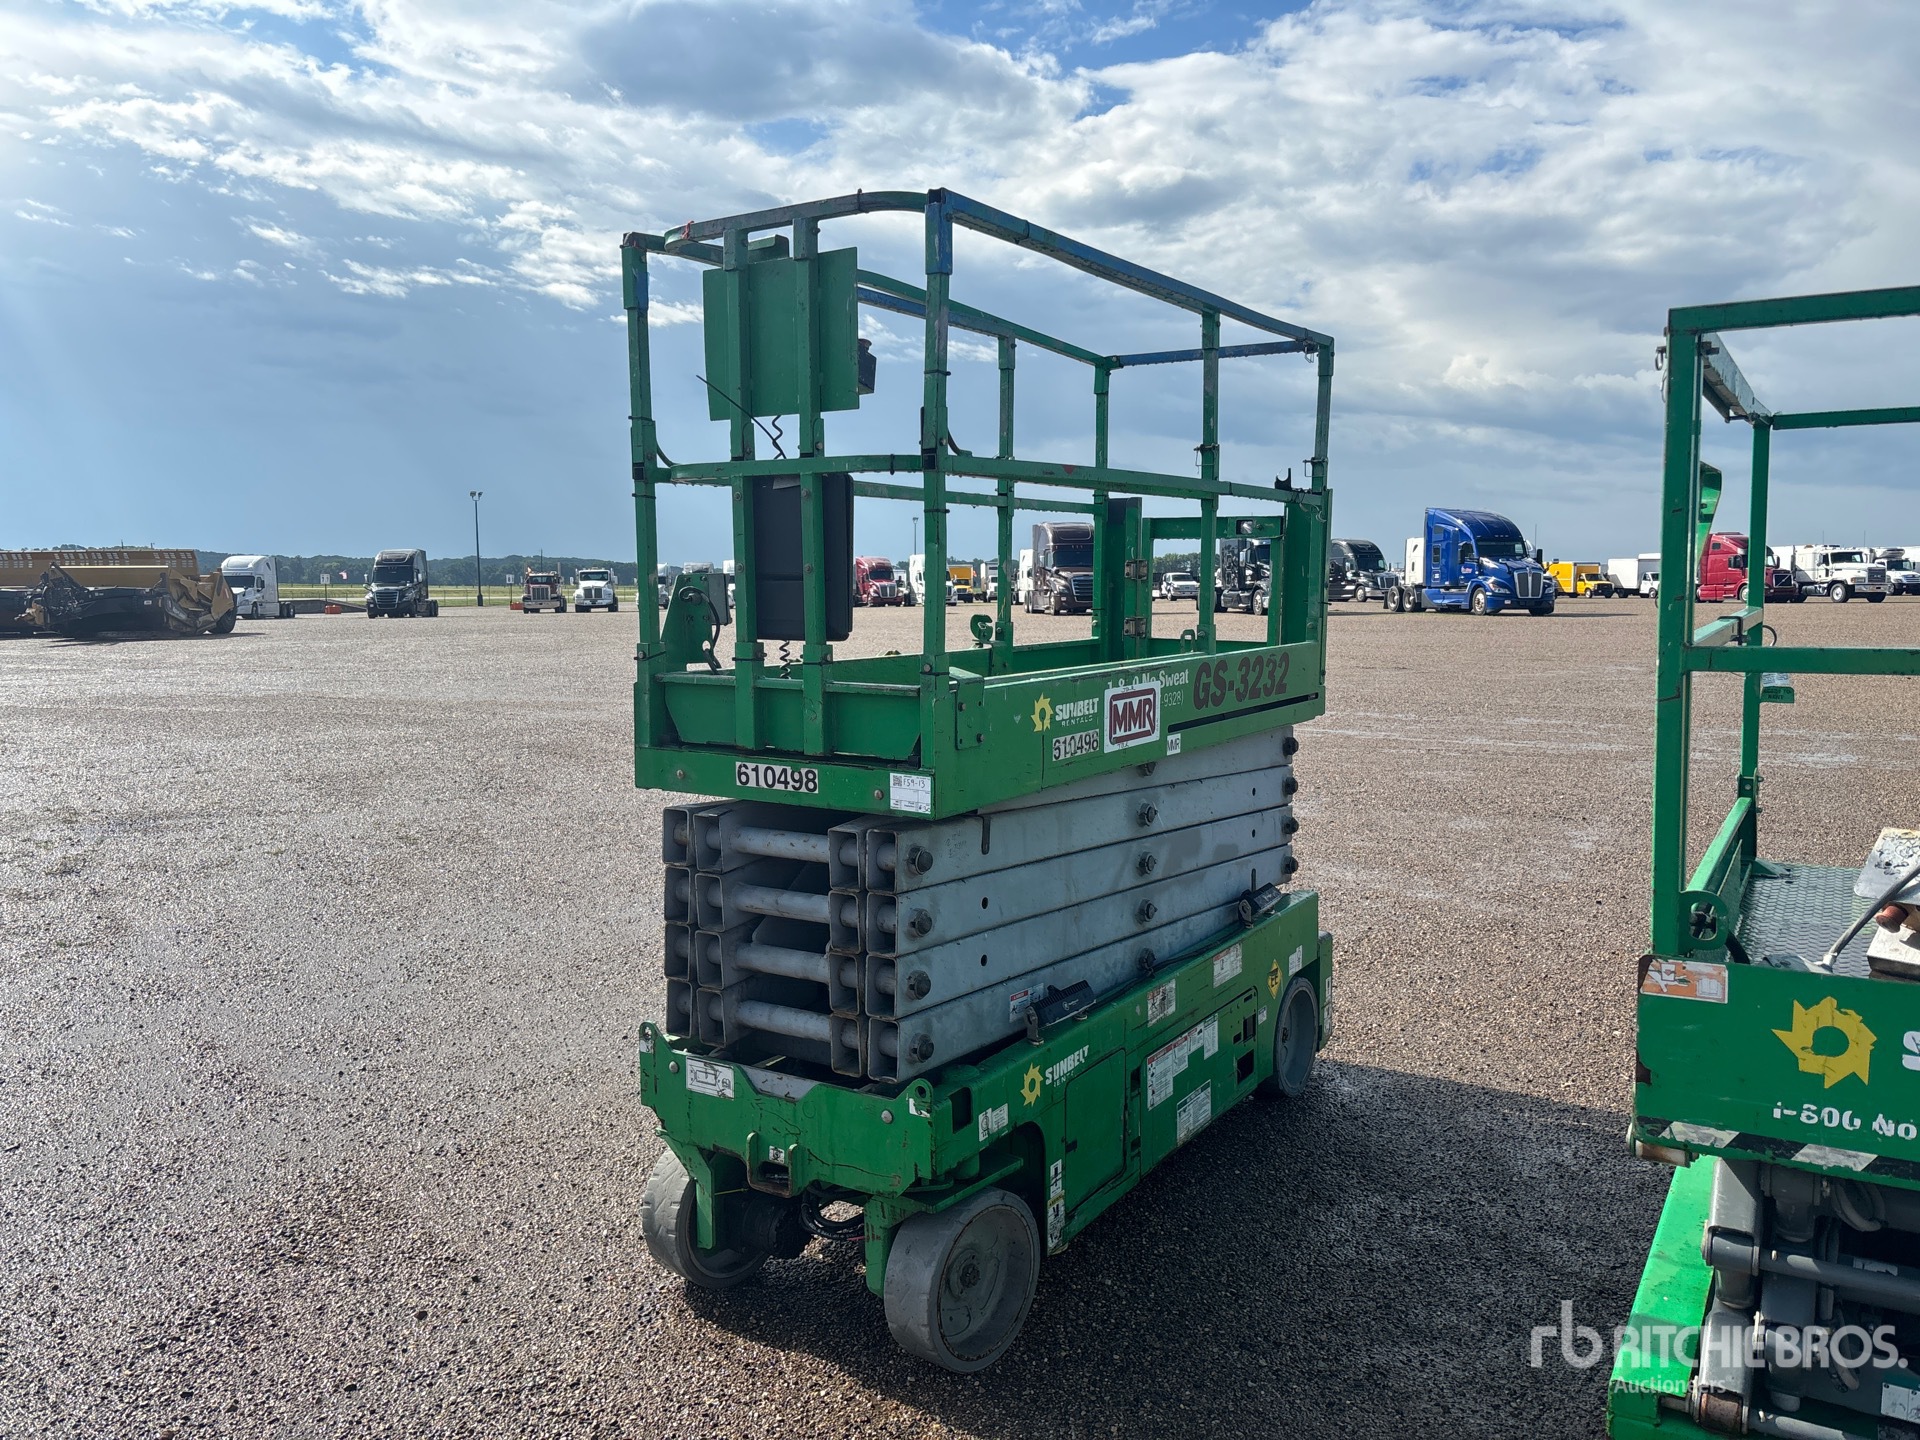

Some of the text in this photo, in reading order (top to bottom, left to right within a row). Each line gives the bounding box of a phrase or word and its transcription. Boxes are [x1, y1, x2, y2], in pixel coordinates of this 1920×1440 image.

[1159, 669, 1189, 688] Sweat
[1193, 652, 1290, 710] GS-3232
[1055, 698, 1100, 721] SUNBELT
[1061, 715, 1094, 727] RENTALS
[1113, 698, 1155, 735] MMR
[1053, 731, 1099, 760] 610498
[737, 762, 818, 793] 610498
[903, 778, 926, 789] F59-13
[1045, 1044, 1090, 1085] SUNBELT
